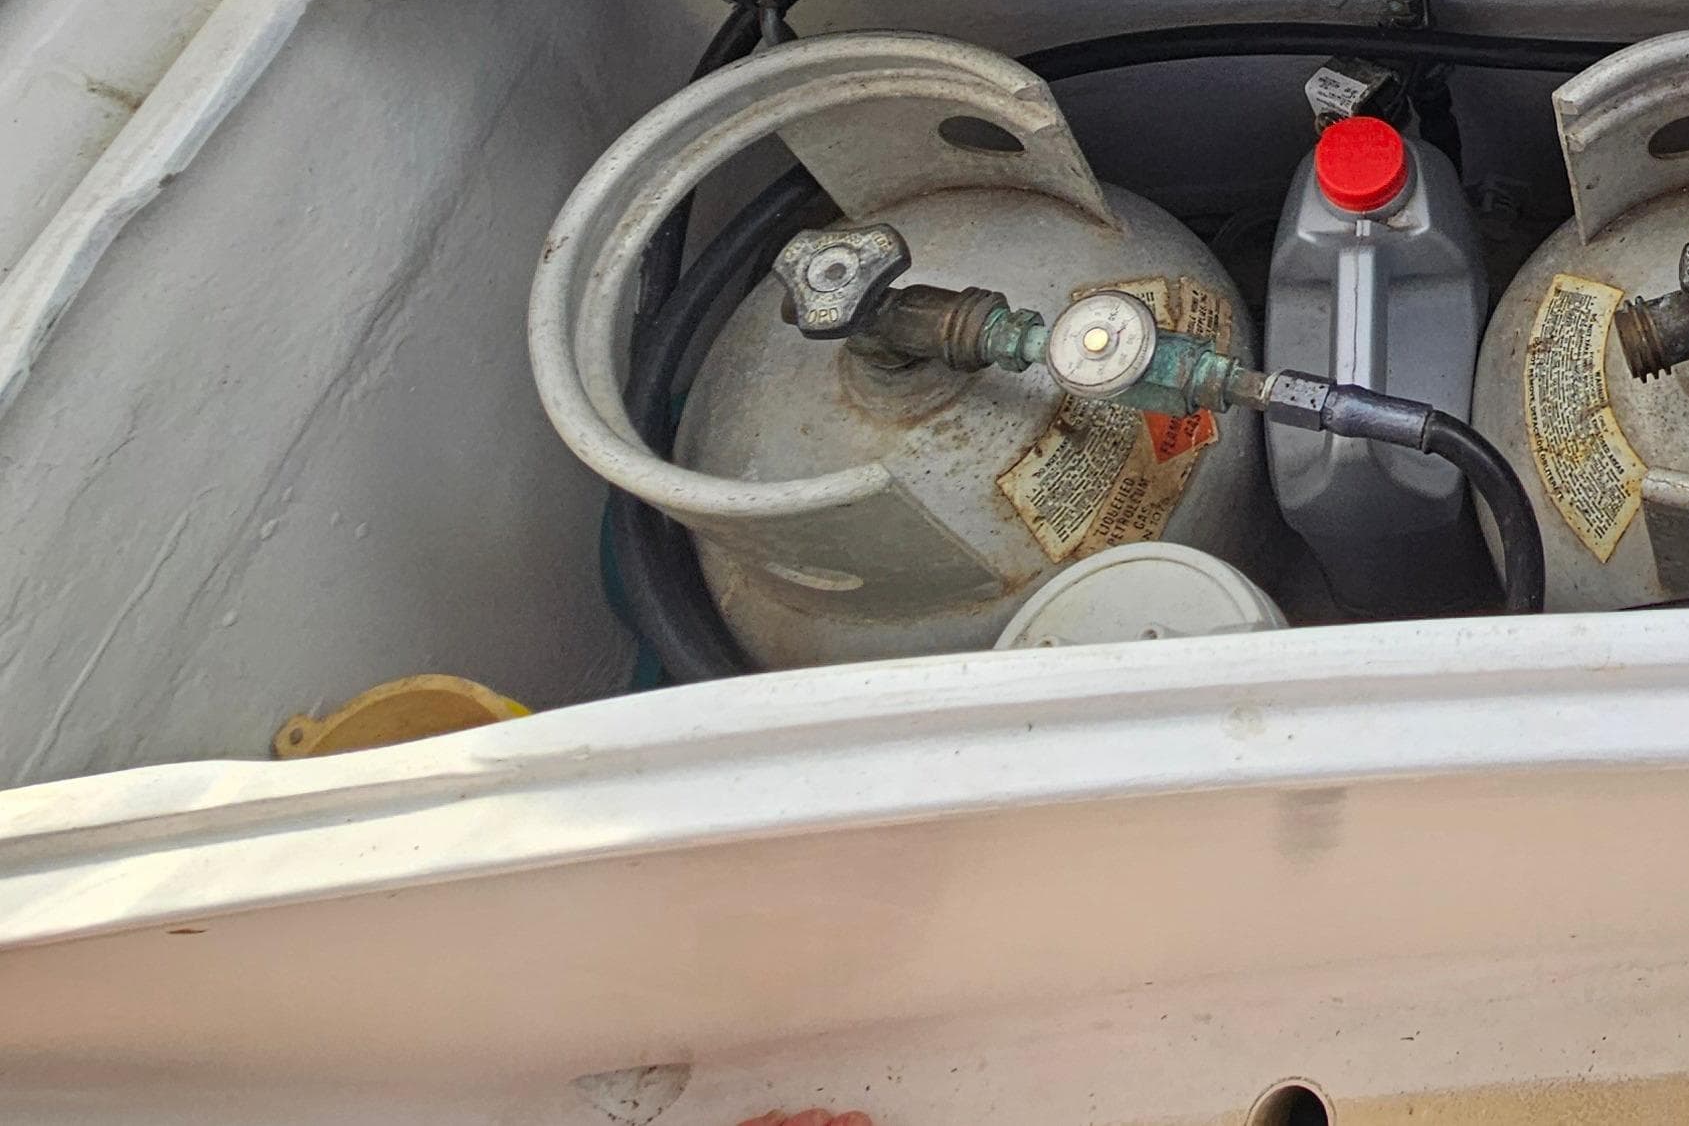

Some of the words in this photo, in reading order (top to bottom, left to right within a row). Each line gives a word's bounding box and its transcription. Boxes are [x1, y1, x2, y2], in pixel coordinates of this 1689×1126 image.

[1044, 453, 1059, 469] NOT
[1608, 454, 1625, 475] AREAS
[1092, 476, 1136, 537] LIQUEFIED
[1106, 477, 1151, 545] PETROLEUM
